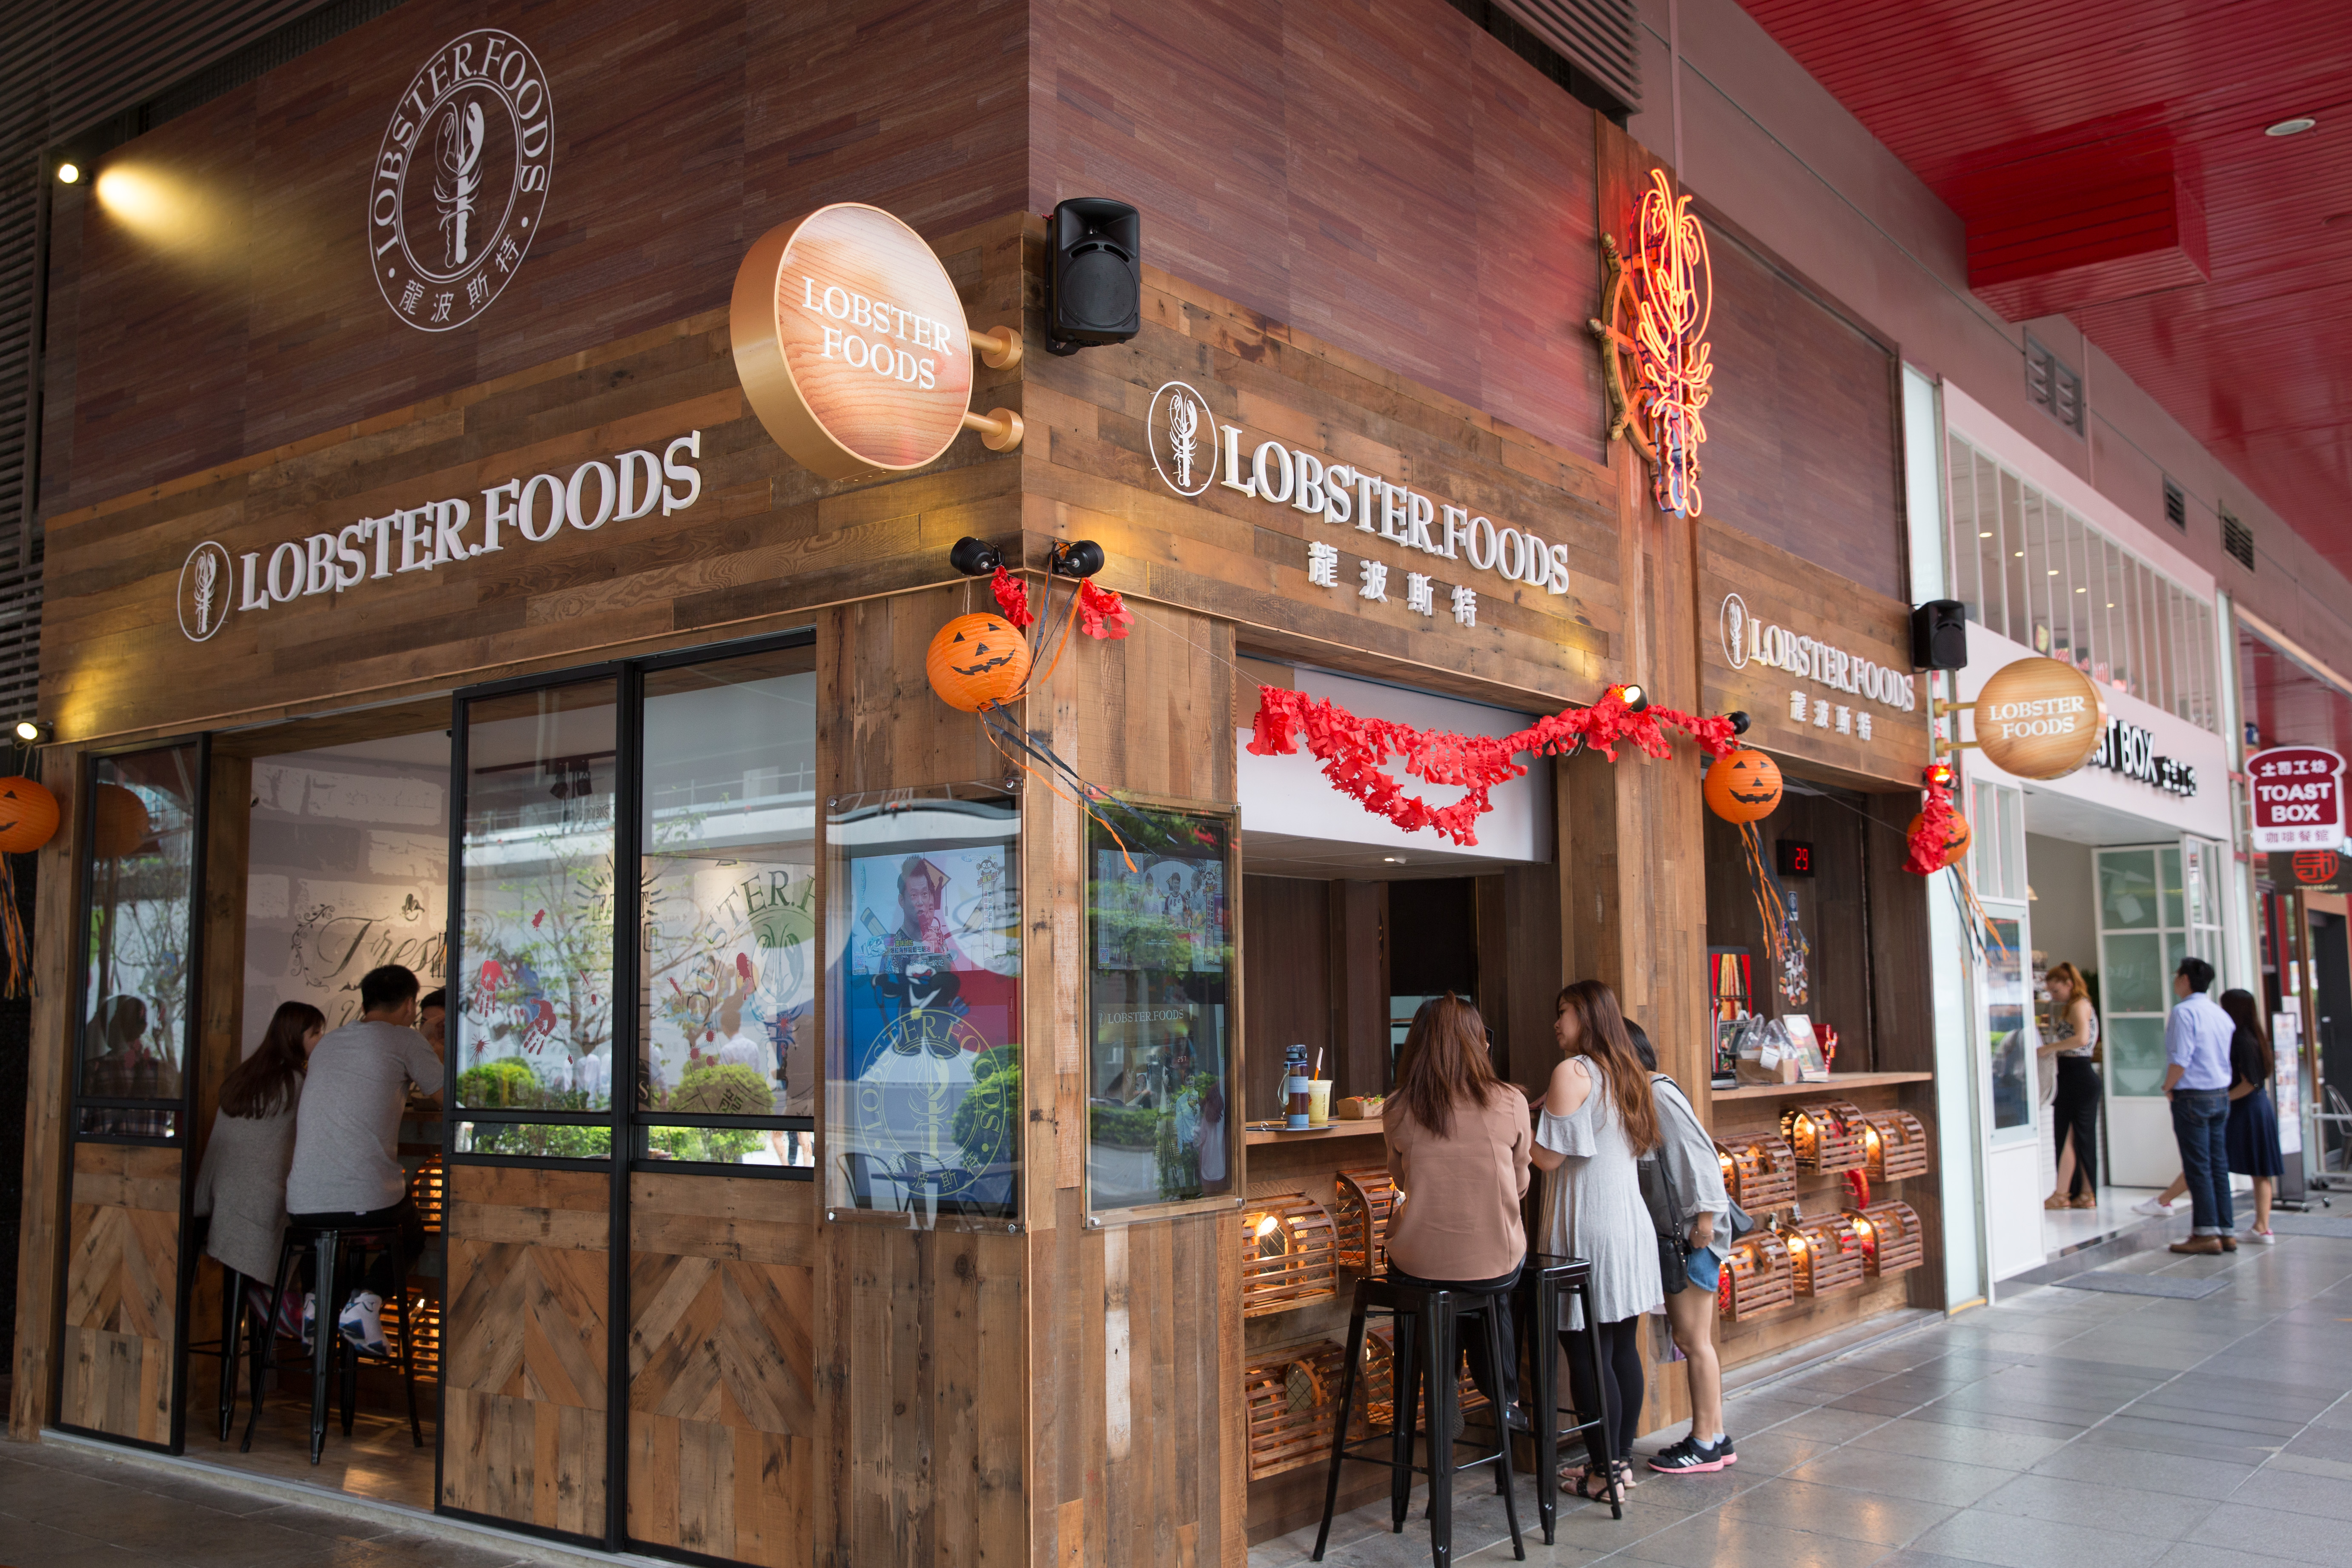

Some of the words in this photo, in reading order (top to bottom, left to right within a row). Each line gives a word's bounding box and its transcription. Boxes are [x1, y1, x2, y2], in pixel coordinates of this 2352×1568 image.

[374, 37, 548, 261] LOBSTER.FOODS
[399, 234, 520, 323] 龍波斯特
[802, 276, 952, 356] LOBSTER
[821, 326, 935, 390] FOODS
[238, 430, 702, 612] LOBSTER.FOODS
[1220, 424, 1568, 595] LOBSTER.FOODS
[1307, 541, 1477, 628] 龍波斯特
[1989, 695, 2086, 721] LOBSTER
[2002, 716, 2075, 740] FOODS
[2120, 719, 2158, 783] BOX
[2260, 759, 2328, 777] 土司工坊
[2257, 782, 2333, 802] TOAST
[2271, 803, 2321, 823] BOX
[1795, 848, 1808, 870] 29
[2265, 830, 2329, 843] 咖啡餐館
[1108, 1009, 1183, 1024] LOBSTER.FOODS
[861, 1015, 1001, 1133] LOBSTER.FOODS
[885, 1150, 982, 1192] 龍波斯特
